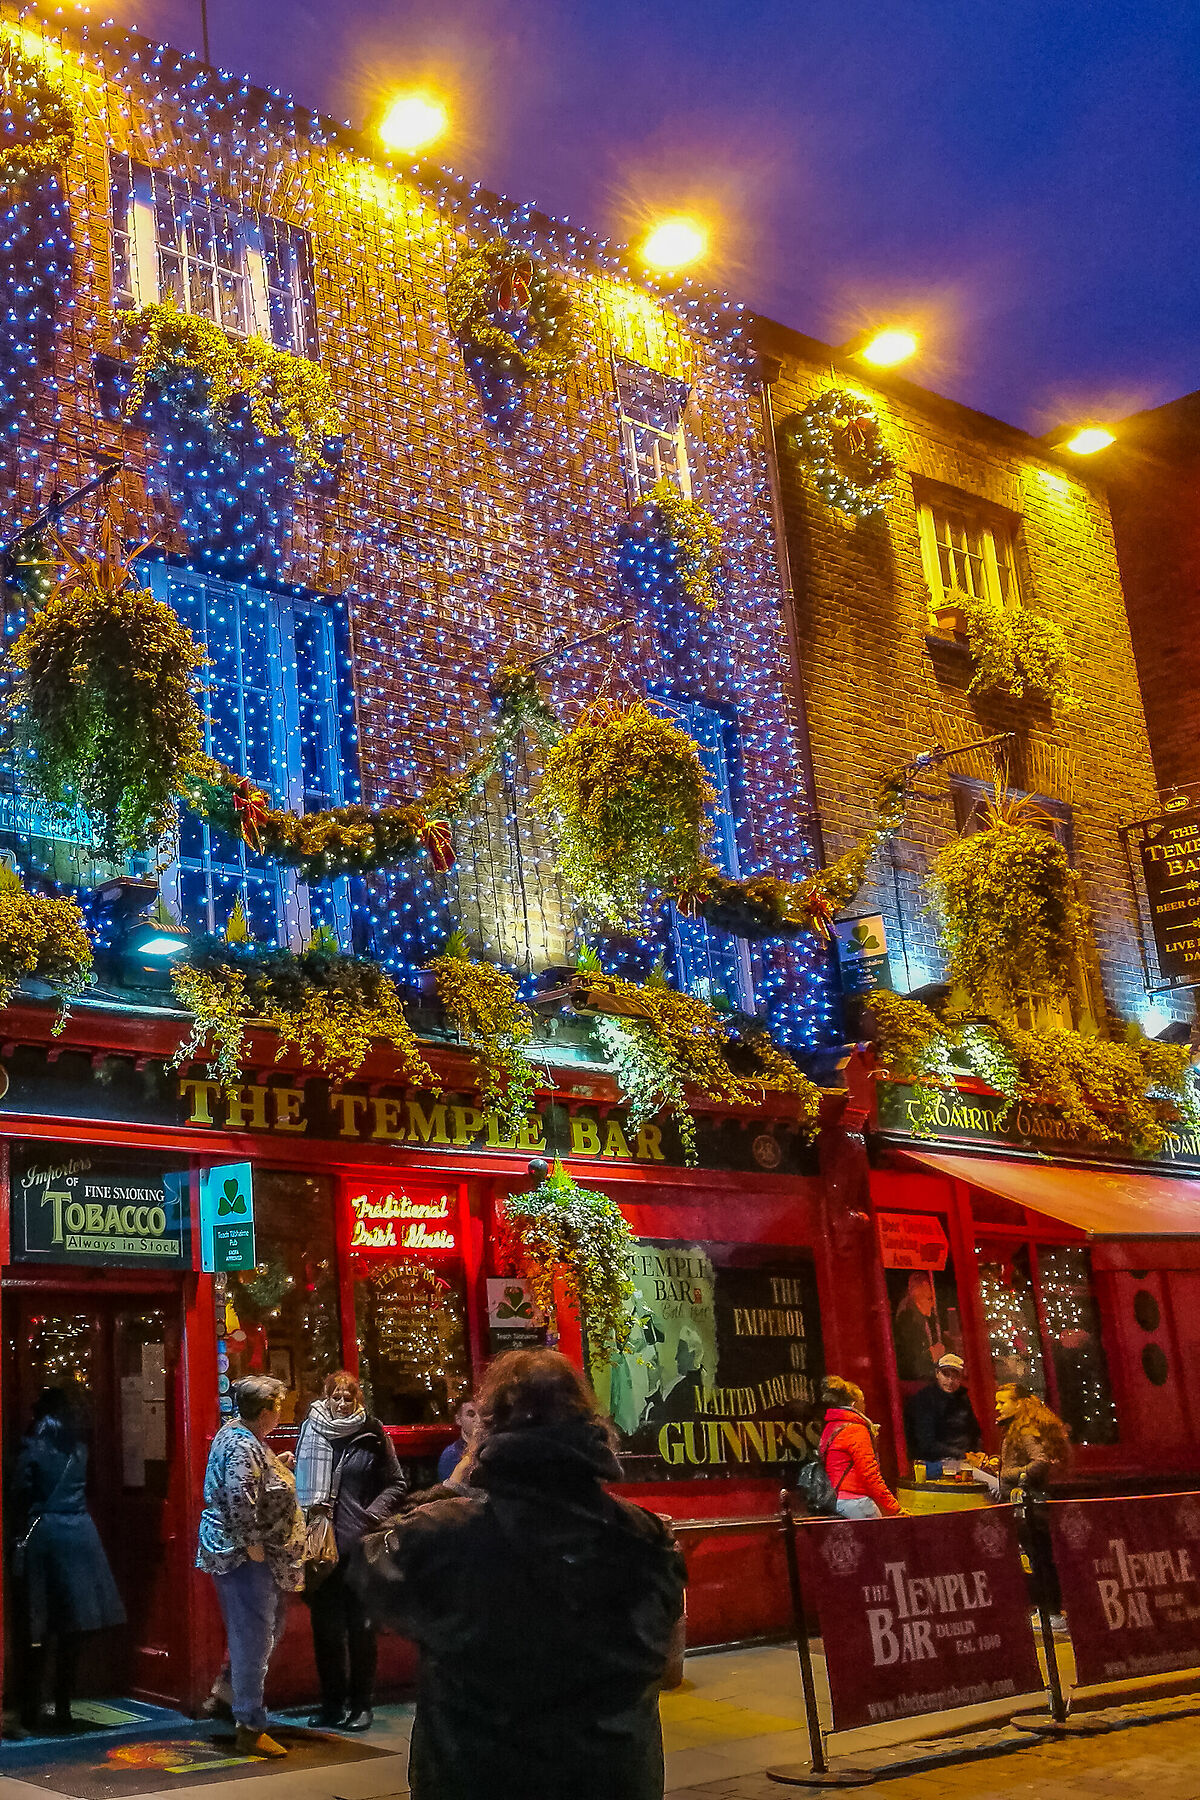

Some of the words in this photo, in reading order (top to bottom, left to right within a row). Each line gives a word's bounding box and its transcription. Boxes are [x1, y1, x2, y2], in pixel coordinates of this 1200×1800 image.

[1169, 824, 1200, 840] THE
[1156, 900, 1186, 914] BEER
[1165, 940, 1195, 953] LIVE
[180, 1079, 308, 1132] THE
[330, 1093, 547, 1151] TEMPLE
[569, 1116, 665, 1160] BAR
[21, 1158, 92, 1191] Importers
[66, 1177, 79, 1187] OF
[84, 1185, 112, 1199] FINE
[113, 1187, 165, 1202] SMOKING
[351, 1195, 449, 1219] Traditional
[40, 1190, 167, 1244] TOBACCO
[67, 1236, 116, 1250] Always
[123, 1239, 135, 1249] in
[140, 1239, 179, 1253] Stock
[351, 1220, 397, 1247] Irish
[404, 1222, 455, 1249] Music
[653, 1279, 695, 1305] BAR
[769, 1277, 803, 1305] THE
[733, 1308, 806, 1337] EMPEROR
[694, 1385, 757, 1416] MALTED
[658, 1420, 822, 1465] GUINNESS
[1108, 1538, 1196, 1590] TEMPLE
[862, 1584, 890, 1603] THE
[884, 1560, 993, 1619] TEMPLE
[1097, 1579, 1154, 1631] BAR
[866, 1607, 938, 1667] BAR
